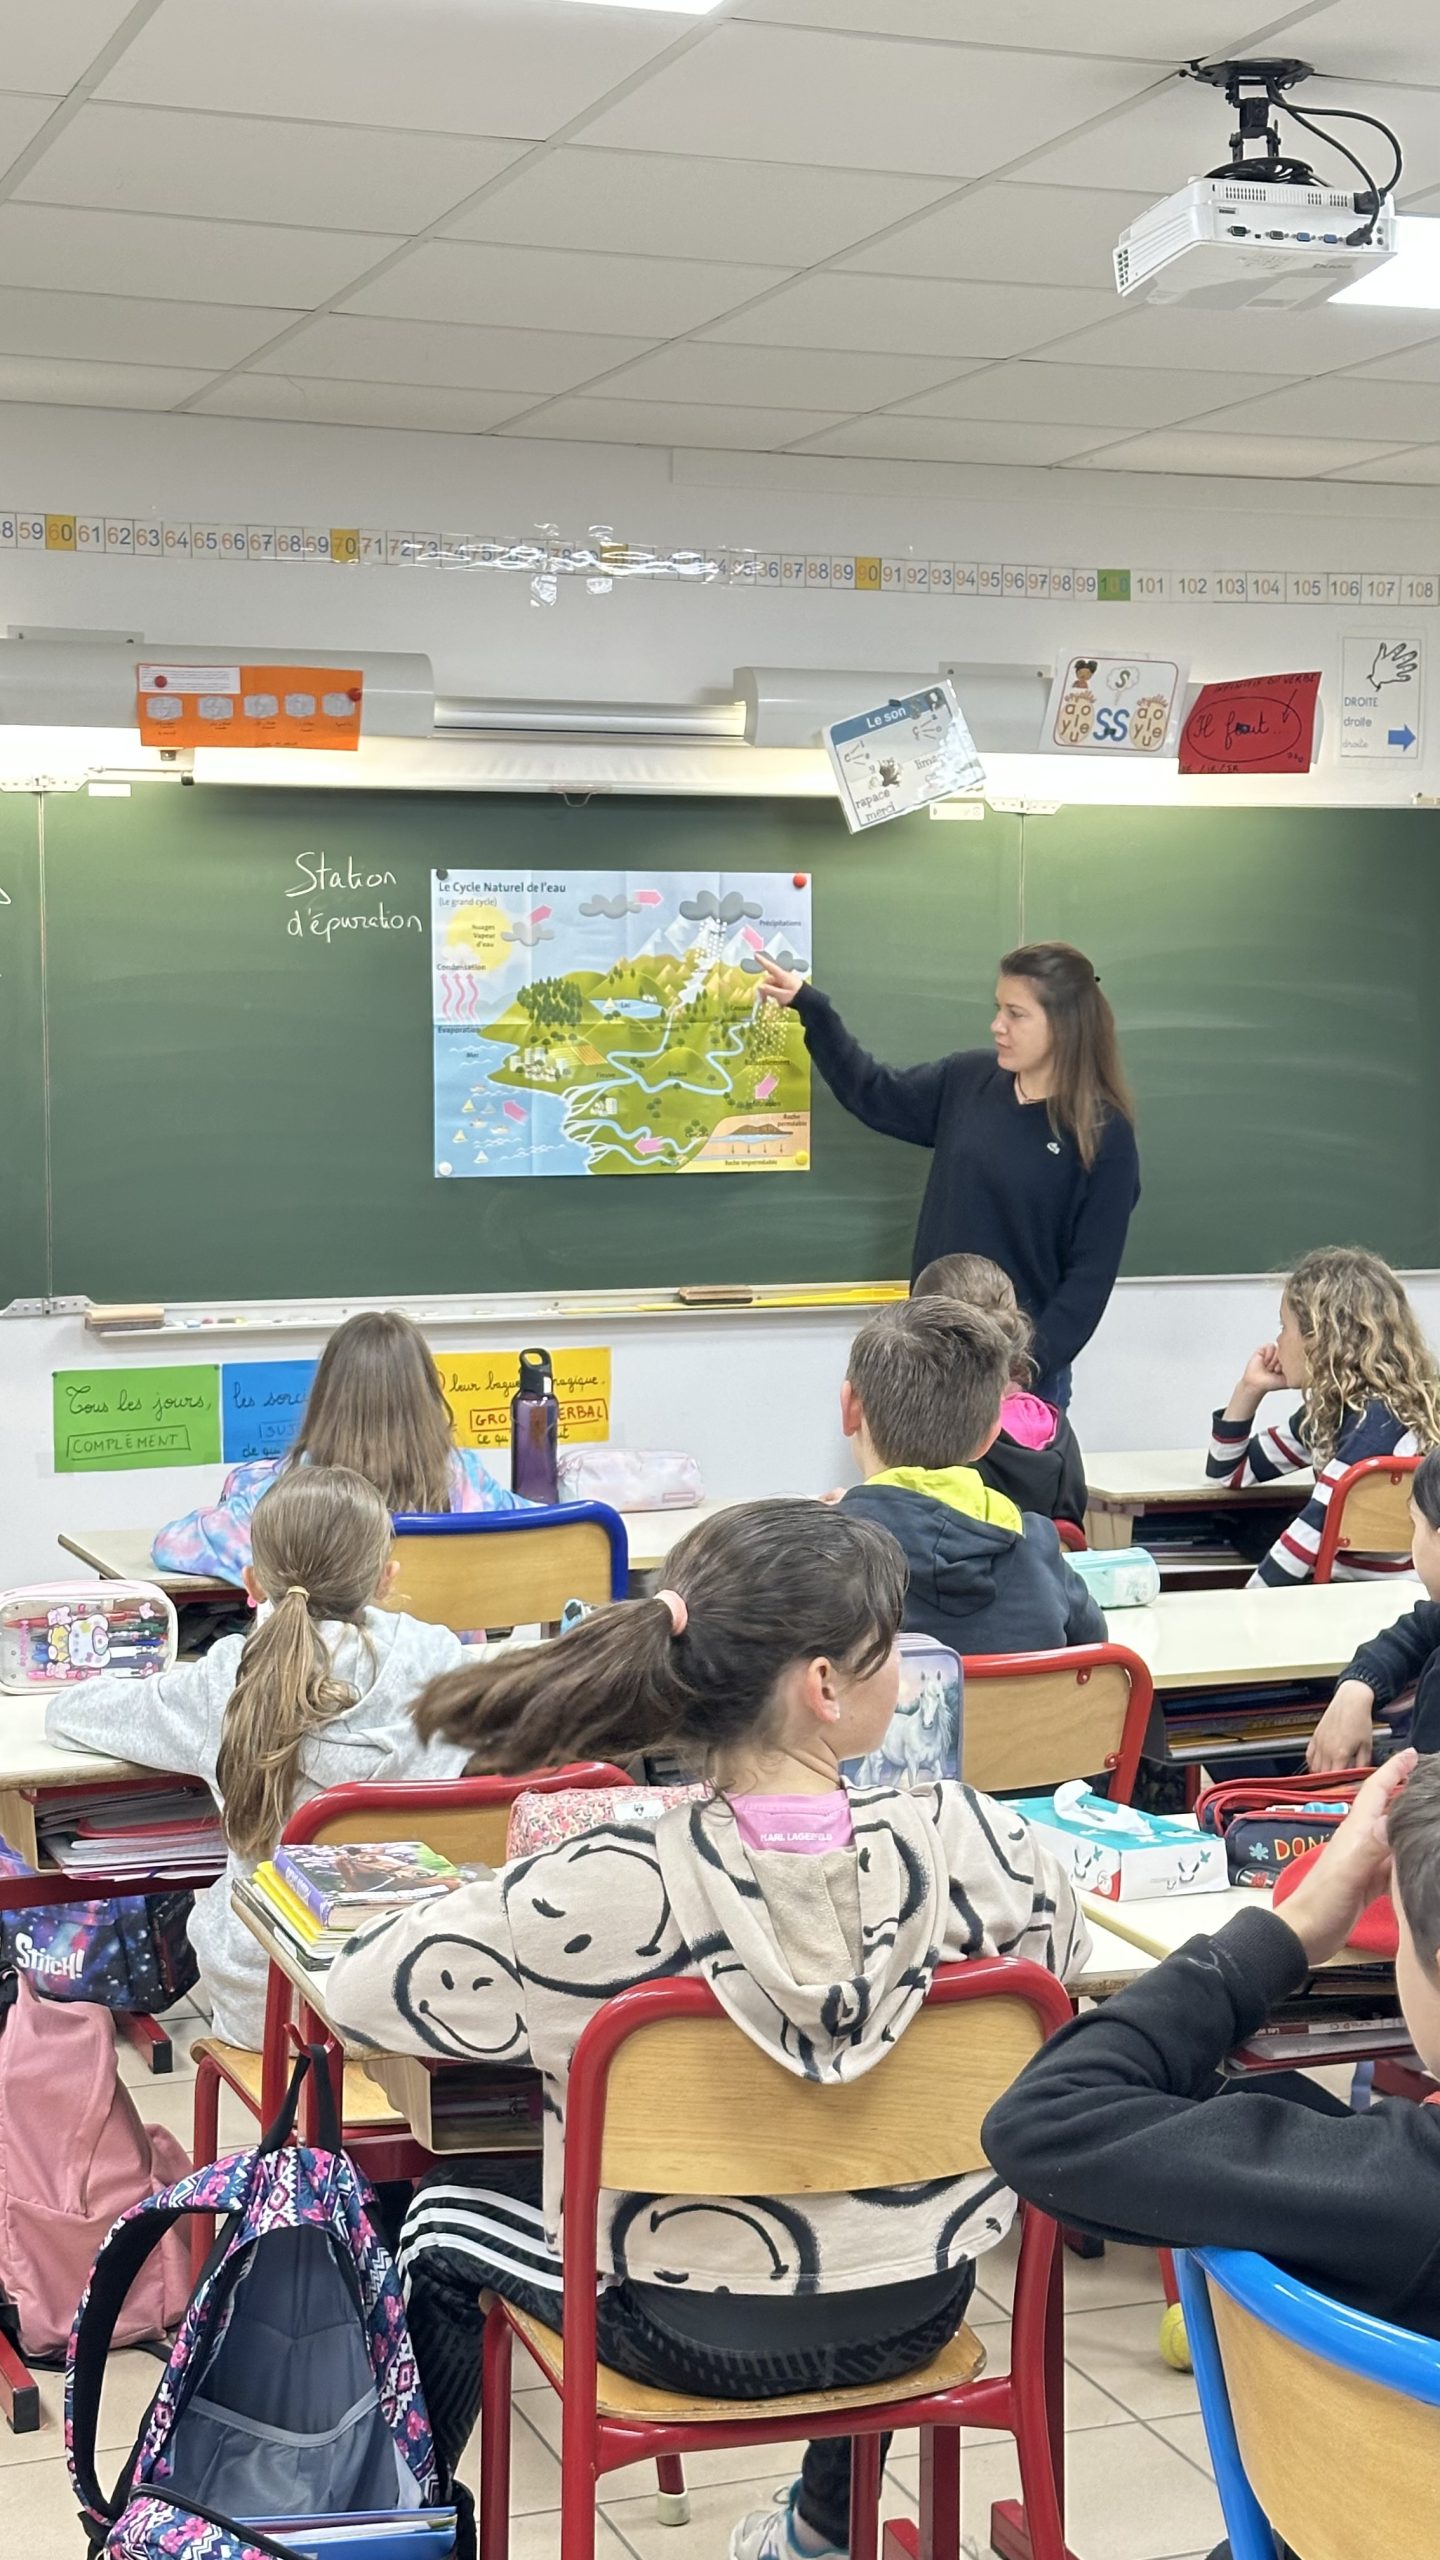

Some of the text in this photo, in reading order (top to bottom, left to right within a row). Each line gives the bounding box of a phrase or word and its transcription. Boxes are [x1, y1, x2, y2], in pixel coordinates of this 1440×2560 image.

[19, 522, 43, 539] 59
[50, 523, 72, 542] 60
[78, 525, 100, 543] 61
[108, 527, 131, 545] 62
[136, 529, 160, 547] 63
[165, 530, 188, 548] 64
[194, 531, 217, 550] 65
[222, 532, 245, 550] 66
[250, 533, 273, 551] 67
[278, 534, 301, 552] 68
[306, 535, 329, 553] 69
[334, 536, 357, 554] 70
[361, 538, 382, 555] 71
[389, 539, 411, 557] 72
[783, 562, 803, 578] 87
[808, 562, 829, 580] 88
[833, 564, 854, 580] 89
[858, 564, 878, 581] 90
[882, 566, 902, 583] 91
[907, 567, 928, 585] 92
[932, 568, 952, 585] 93
[956, 568, 976, 586] 94
[980, 568, 1000, 586] 95
[1004, 570, 1025, 588] 96
[1028, 571, 1048, 589] 97
[1052, 573, 1072, 591] 98
[1076, 576, 1096, 593] 99
[1101, 576, 1129, 593] 100
[1137, 576, 1164, 594] 101
[1178, 578, 1207, 595] 102
[1216, 579, 1245, 595] 103
[1253, 580, 1280, 596] 104
[1294, 580, 1321, 596] 105
[1330, 580, 1359, 597] 106
[1368, 582, 1395, 598] 107
[1408, 582, 1433, 598] 108
[1344, 696, 1378, 708] DROITE
[866, 706, 906, 729] Le son
[1344, 716, 1372, 728] droite
[1225, 711, 1270, 750] fut
[854, 789, 891, 810] rapace
[866, 802, 897, 823] merci
[284, 851, 398, 898] Station
[439, 882, 566, 895] Le Cycle Naturel de l'eau
[452, 897, 474, 908] grand
[286, 902, 423, 943] d'épuration
[473, 932, 496, 940] Vapeur
[485, 1371, 520, 1398] bague
[552, 1375, 598, 1392] agique
[66, 1385, 212, 1422] Tous les jours,
[234, 1382, 256, 1409] les
[476, 1405, 604, 1426] GRO ERBAL
[266, 1424, 296, 1438] SUJ
[74, 1434, 179, 1454] COMPLÉMENT
[242, 1442, 259, 1458] de
[760, 1833, 786, 1842] KARL
